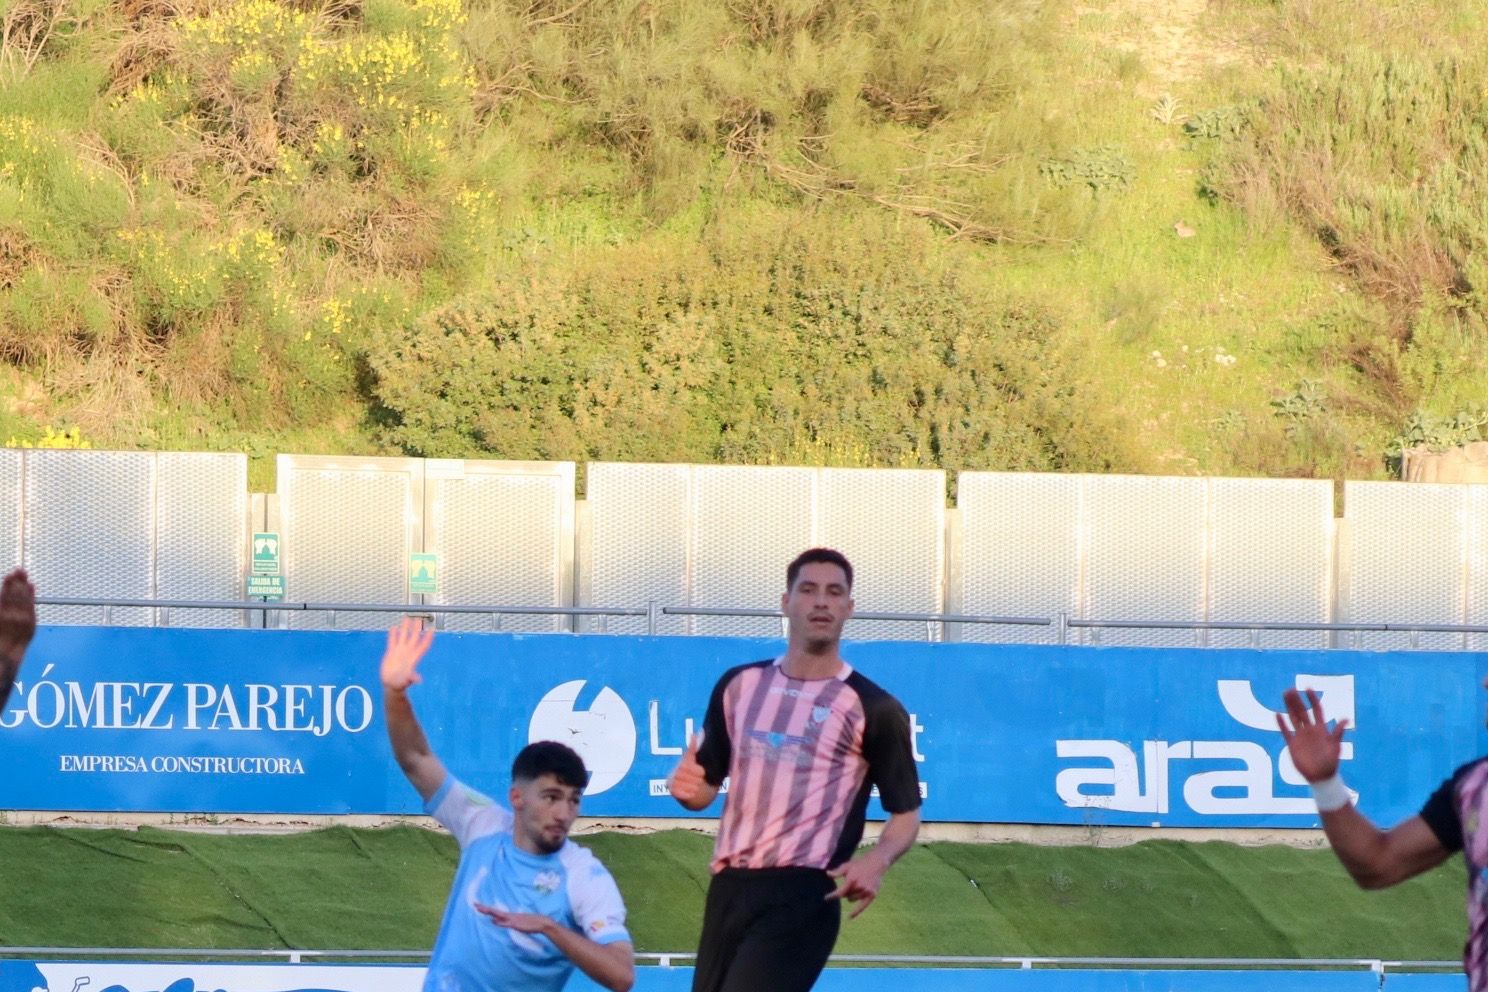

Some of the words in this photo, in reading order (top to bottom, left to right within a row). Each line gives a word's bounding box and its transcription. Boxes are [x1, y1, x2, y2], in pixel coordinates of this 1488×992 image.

[183, 683, 373, 736] PAREJO
[60, 755, 149, 773] EMPRESA
[151, 756, 305, 775] CONSTRUCTORA
